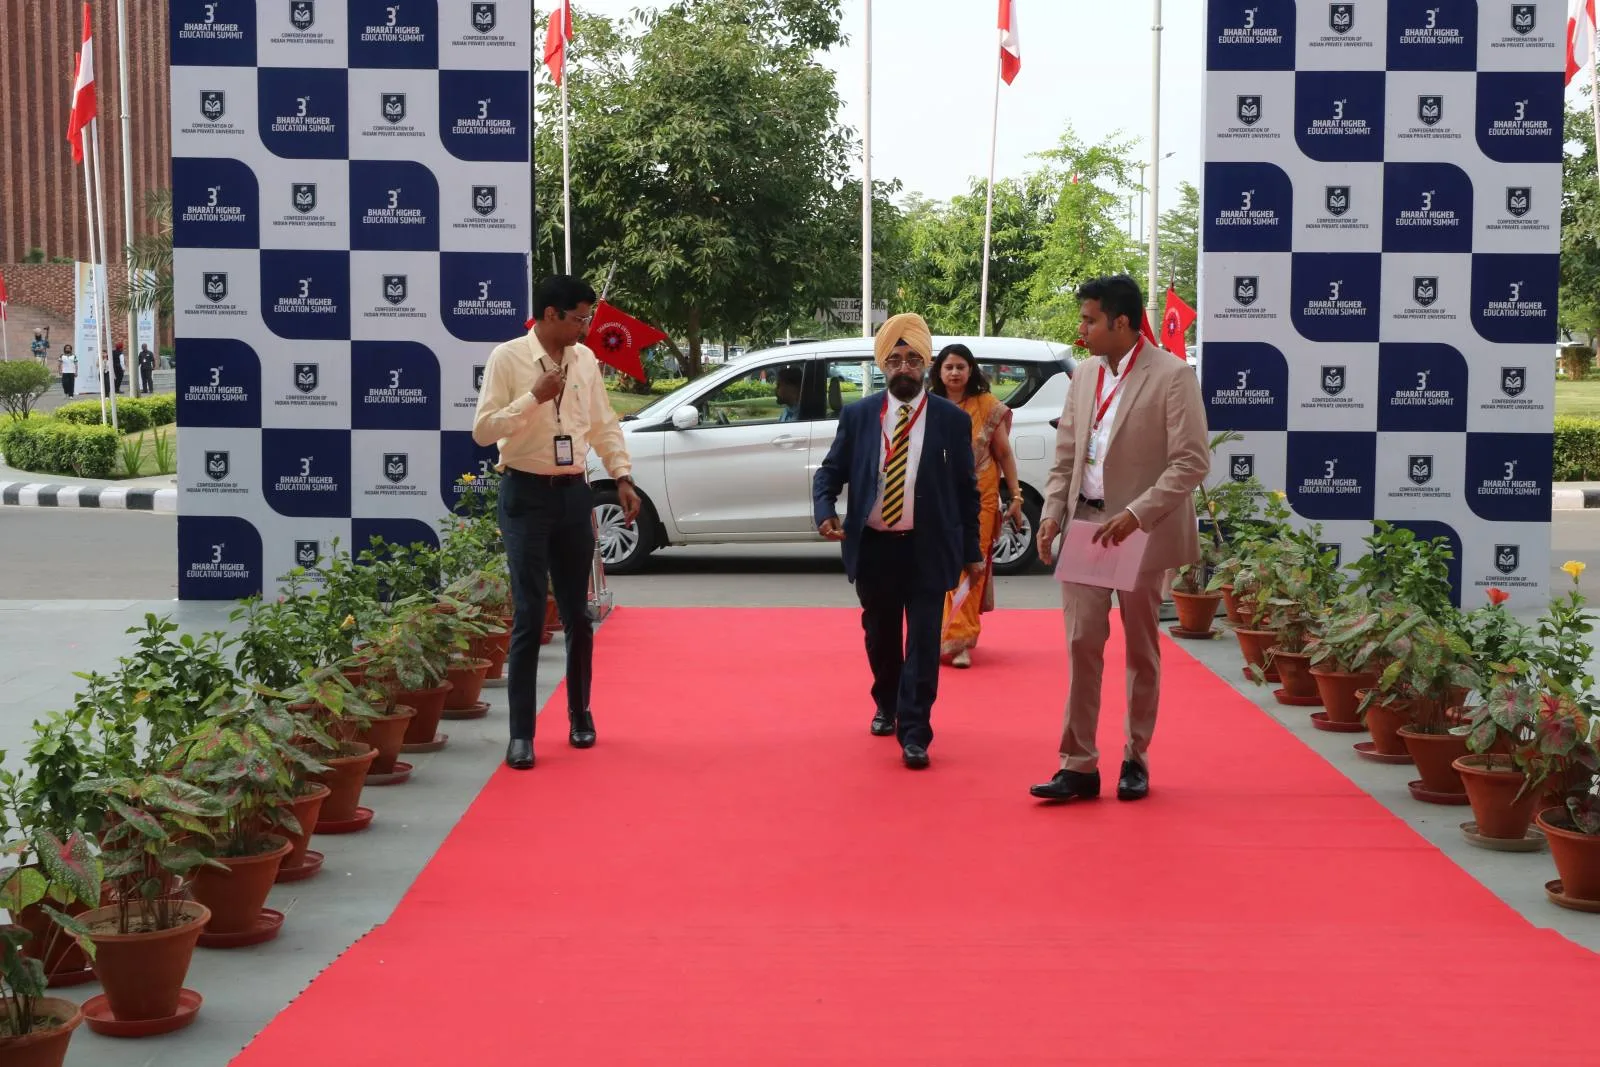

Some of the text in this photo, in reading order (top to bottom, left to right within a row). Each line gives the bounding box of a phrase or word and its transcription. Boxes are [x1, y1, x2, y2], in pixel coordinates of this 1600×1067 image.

[184, 23, 211, 31] BHARAT
[366, 26, 420, 34] BHARAT HIGHER
[217, 31, 243, 39] SUMMIT
[361, 33, 425, 42] EDUCATION SUMMIT
[276, 116, 304, 124] BHARAT
[272, 124, 307, 132] EDUCATION
[452, 126, 516, 135] EDUCATION SUMMIT
[187, 206, 241, 214] BHARAT HIGHER
[368, 208, 394, 216] BHARAT
[1221, 210, 1274, 218] BHARAT HIGHER
[182, 213, 246, 222] EDUCATION SUMMIT
[363, 216, 398, 224] EDUCATION
[307, 298, 332, 306] HIGHER
[458, 300, 512, 308] BHARAT HIGHER
[831, 301, 848, 309] ATER
[274, 305, 338, 314] EDUCATION SUMMIT
[453, 307, 517, 316] EDUCATION SUMMIT
[218, 386, 243, 394] HIGHER
[369, 388, 396, 396] BHARAT
[185, 393, 249, 402] EDUCATION SUMMIT
[401, 396, 428, 404] SUMMIT
[308, 476, 333, 484] HIGHER
[1483, 480, 1536, 488] BHARAT HIGHER
[275, 483, 339, 492] EDUCATION SUMMIT
[220, 563, 245, 571] HIGHER
[186, 570, 250, 579] EDUCATION SUMMIT
